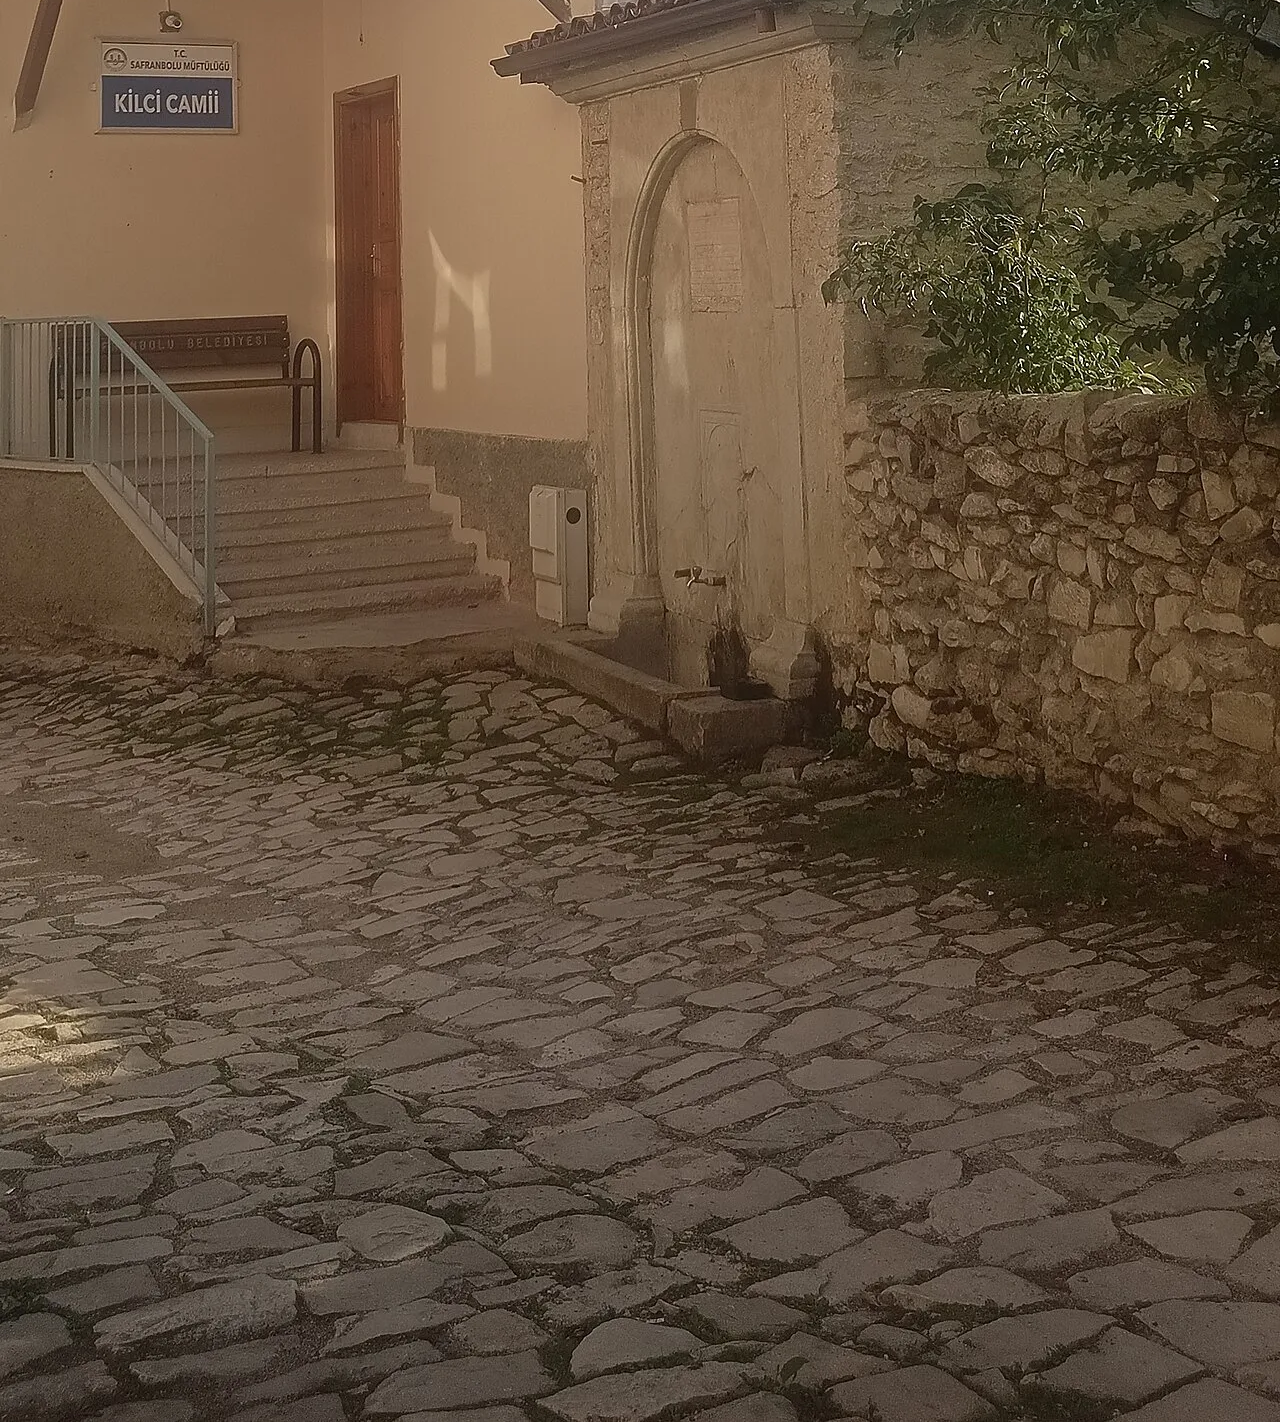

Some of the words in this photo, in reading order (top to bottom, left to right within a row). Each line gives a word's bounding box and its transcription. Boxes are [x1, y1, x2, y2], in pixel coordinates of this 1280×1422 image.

[173, 49, 188, 58] T.C.
[130, 60, 182, 71] SAFRANBOLU
[183, 60, 230, 72] MÜFTÜLÜĞÜ
[115, 88, 161, 114] KİLCİ
[166, 89, 219, 114] CAMİİ
